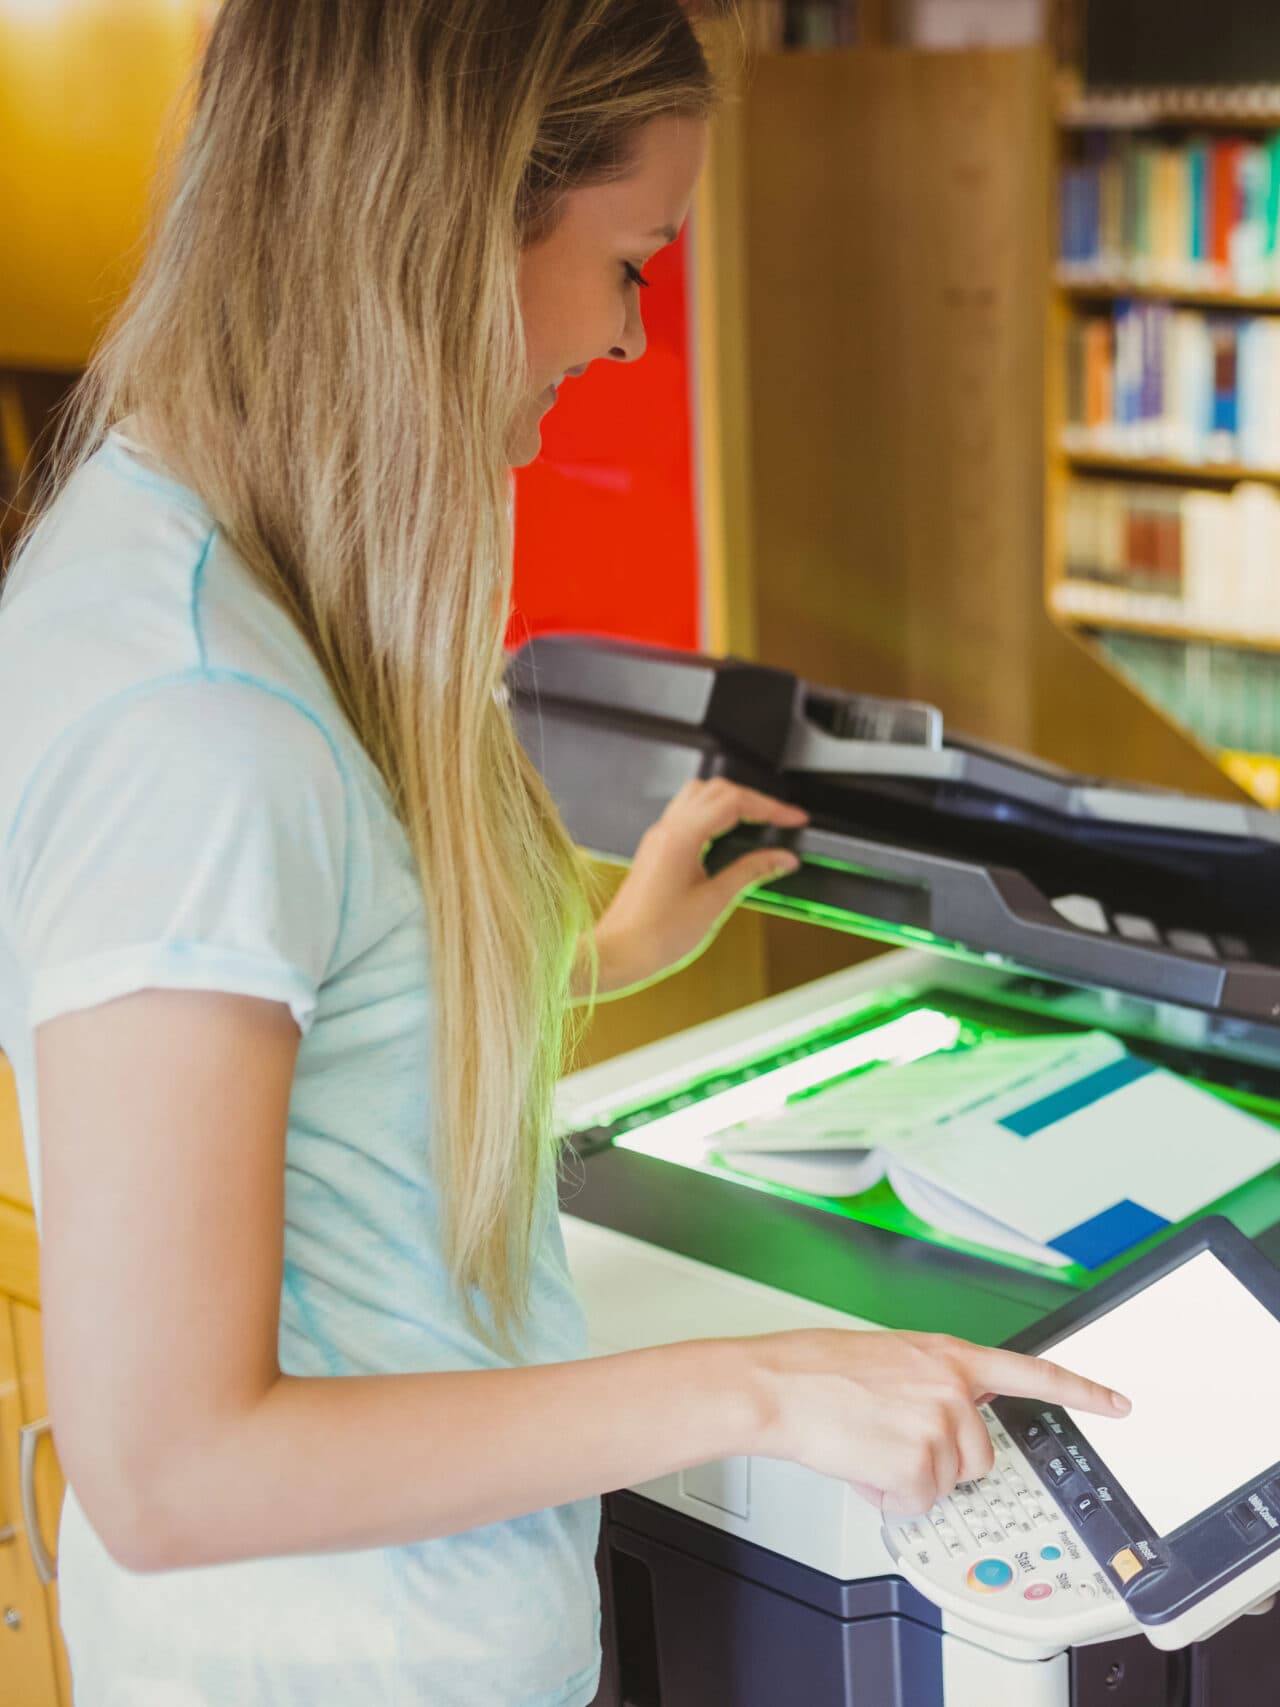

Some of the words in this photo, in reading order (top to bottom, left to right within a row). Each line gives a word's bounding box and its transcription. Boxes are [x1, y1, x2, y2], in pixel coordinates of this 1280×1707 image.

[1097, 1486, 1112, 1501] Copy
[1136, 1540, 1157, 1560] Reset
[1014, 1551, 1036, 1573] Start
[1056, 1572, 1072, 1590] Stop
